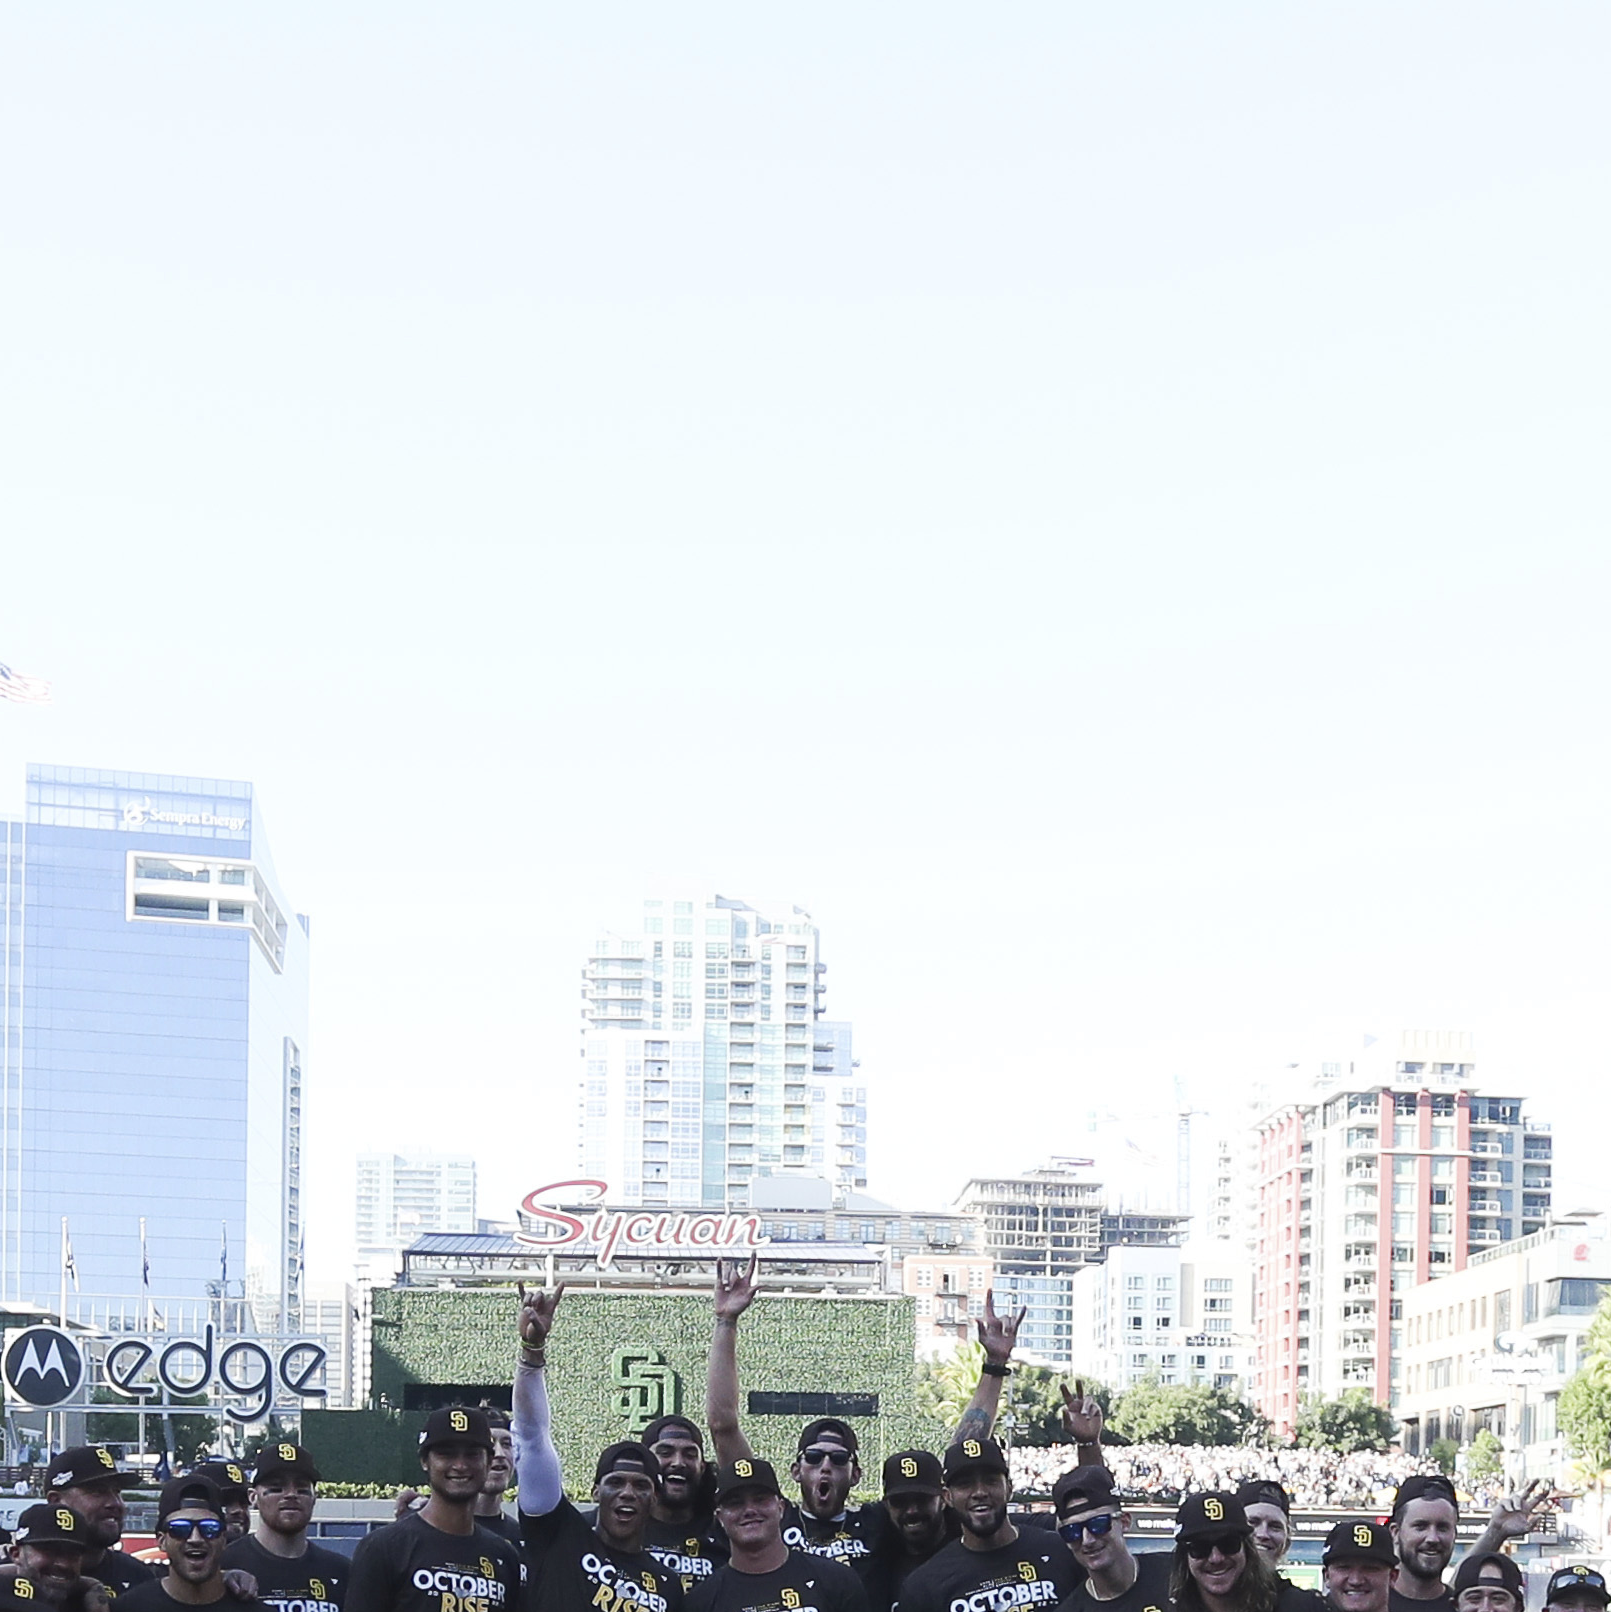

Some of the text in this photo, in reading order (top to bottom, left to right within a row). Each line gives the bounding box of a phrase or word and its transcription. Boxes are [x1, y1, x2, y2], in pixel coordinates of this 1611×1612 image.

[150, 808, 246, 831] Sempra Energy
[513, 1179, 772, 1266] Sycuan
[103, 1322, 329, 1422] edge
[413, 1569, 505, 1600] OCTOBER
